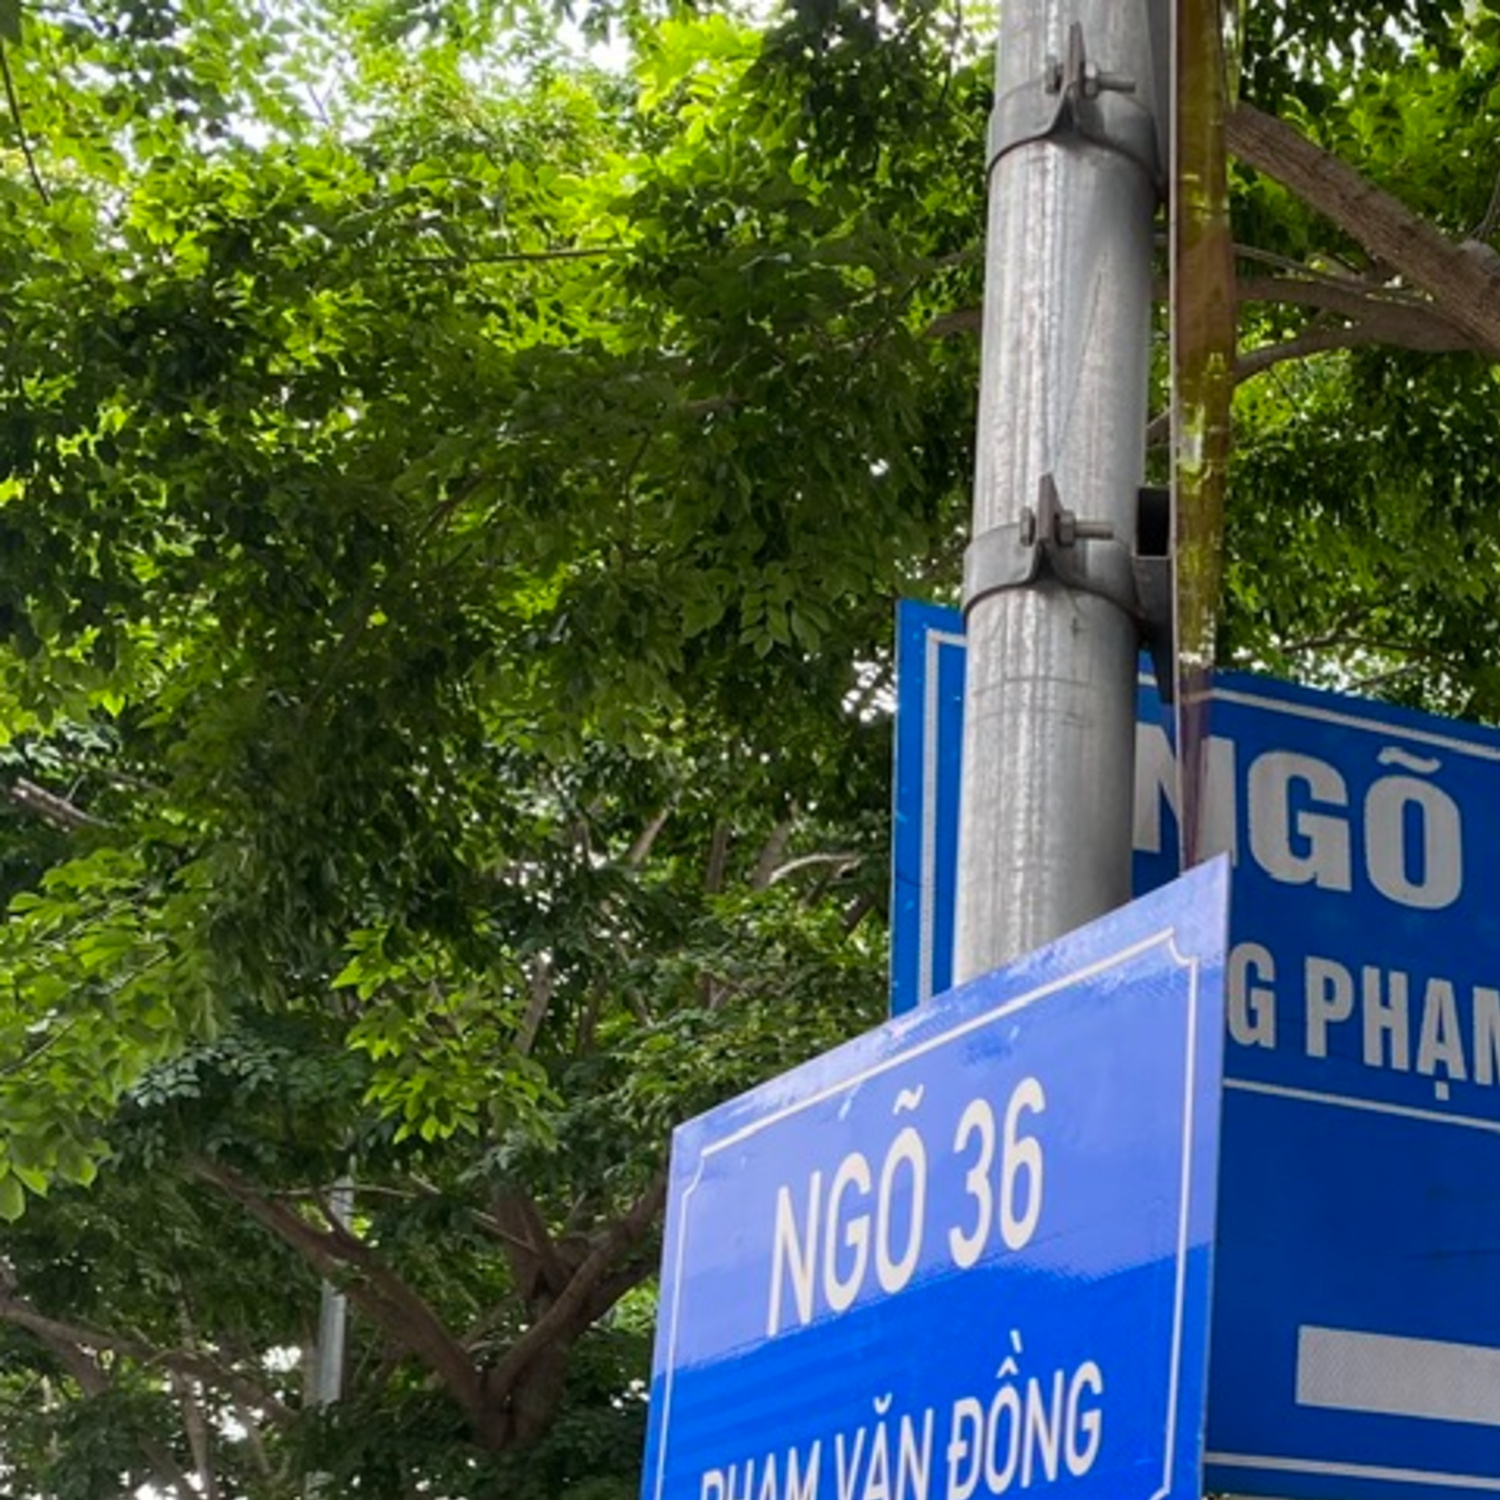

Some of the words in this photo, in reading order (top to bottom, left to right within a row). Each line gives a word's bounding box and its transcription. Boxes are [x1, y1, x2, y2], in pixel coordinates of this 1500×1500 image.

[1132, 720, 1463, 911] NGÕ
[767, 1084, 928, 1338] NGÕ
[949, 1077, 1046, 1270] 36
